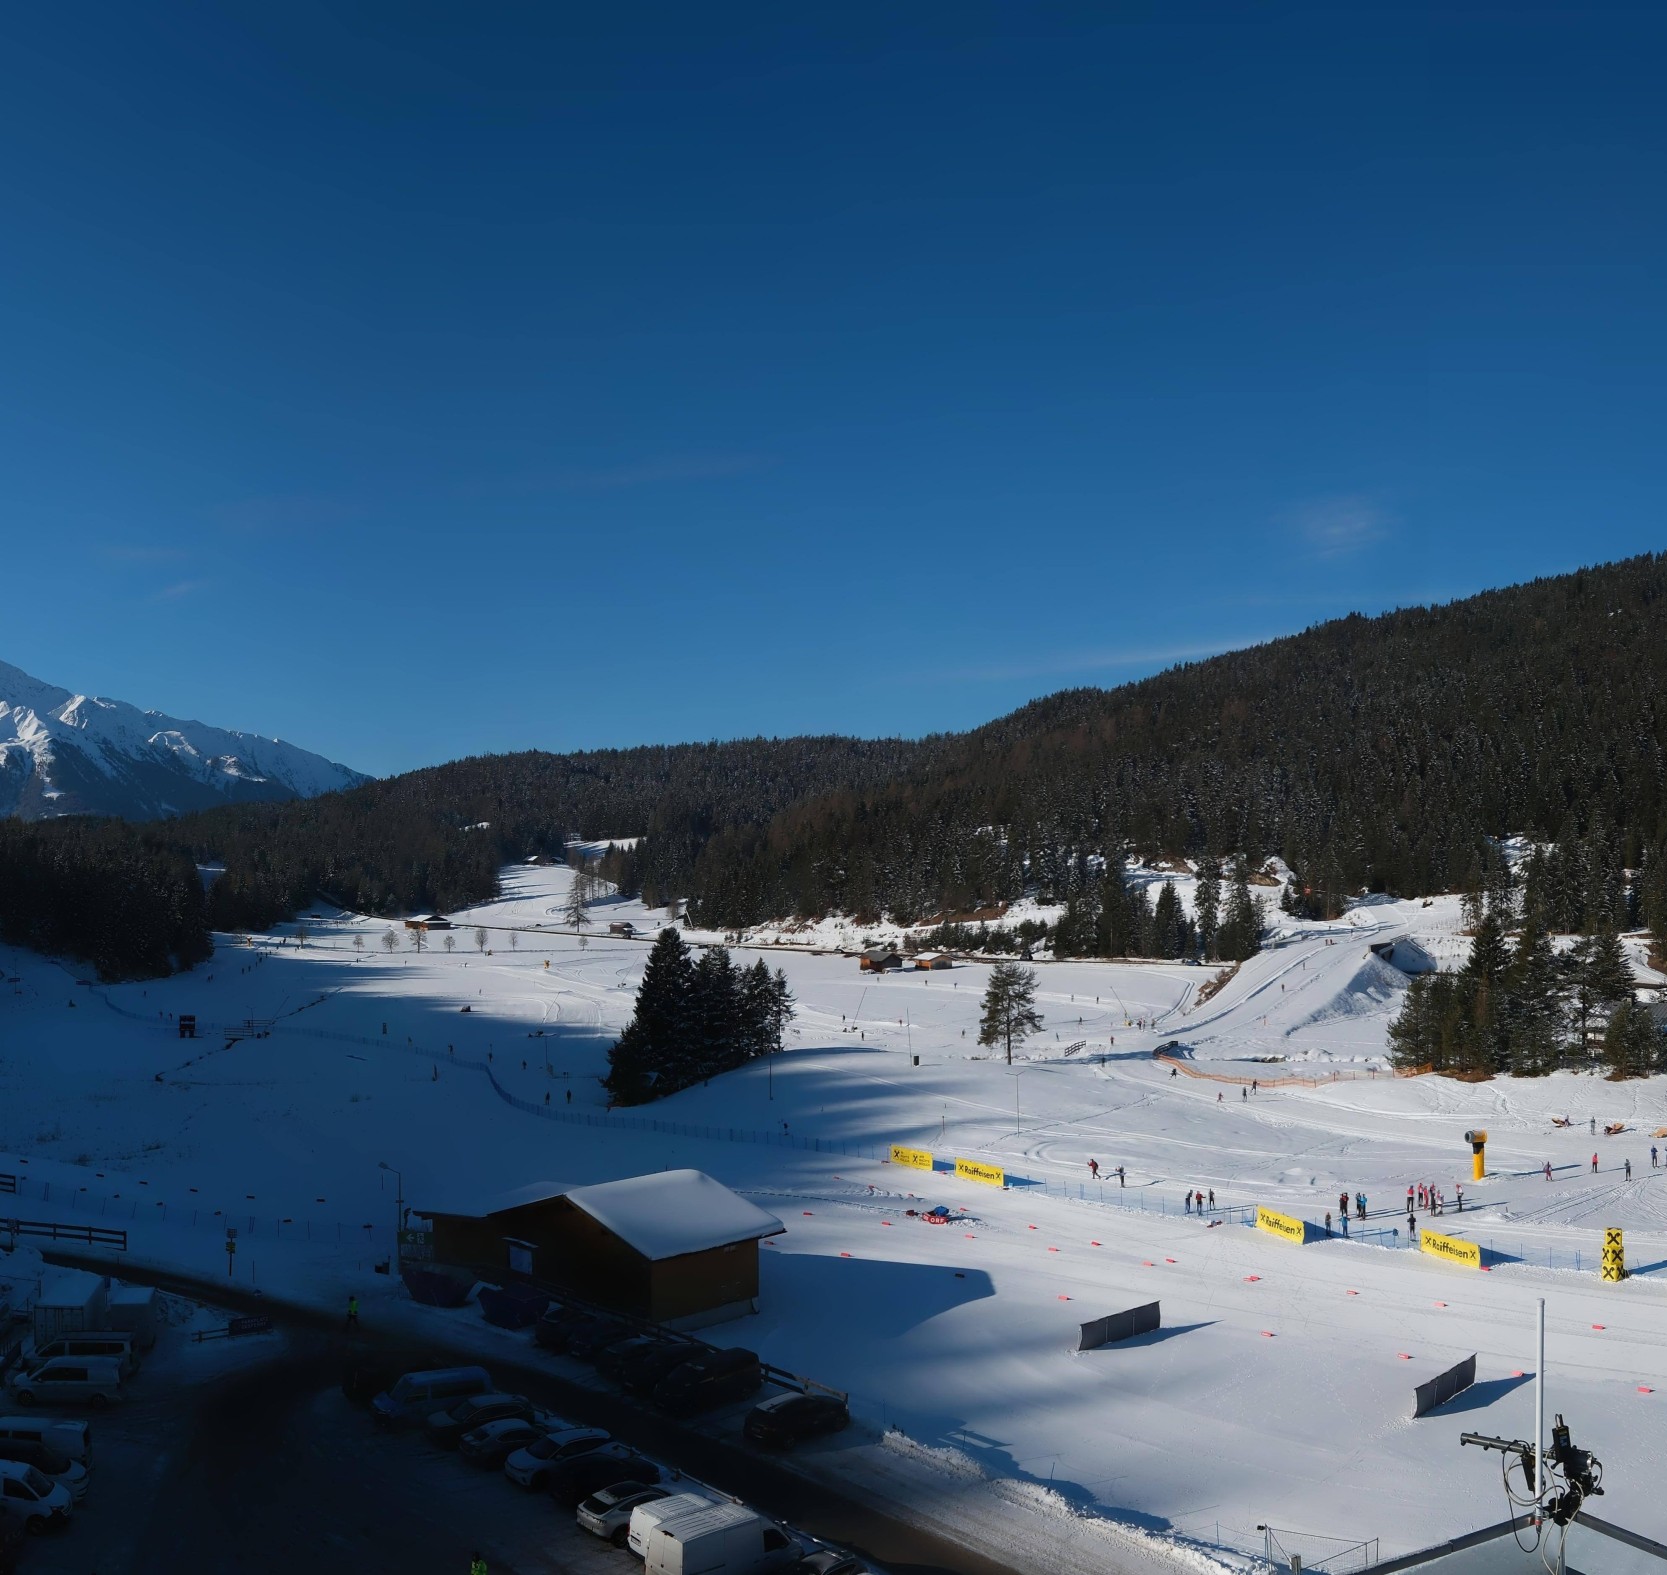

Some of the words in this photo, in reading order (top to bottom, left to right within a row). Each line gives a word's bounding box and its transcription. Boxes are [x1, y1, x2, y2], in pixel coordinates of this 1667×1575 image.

[964, 1165, 995, 1180] Raiffeisen
[1265, 1214, 1296, 1236] Raiffeisen
[1432, 1241, 1468, 1259] Raiffeisen
